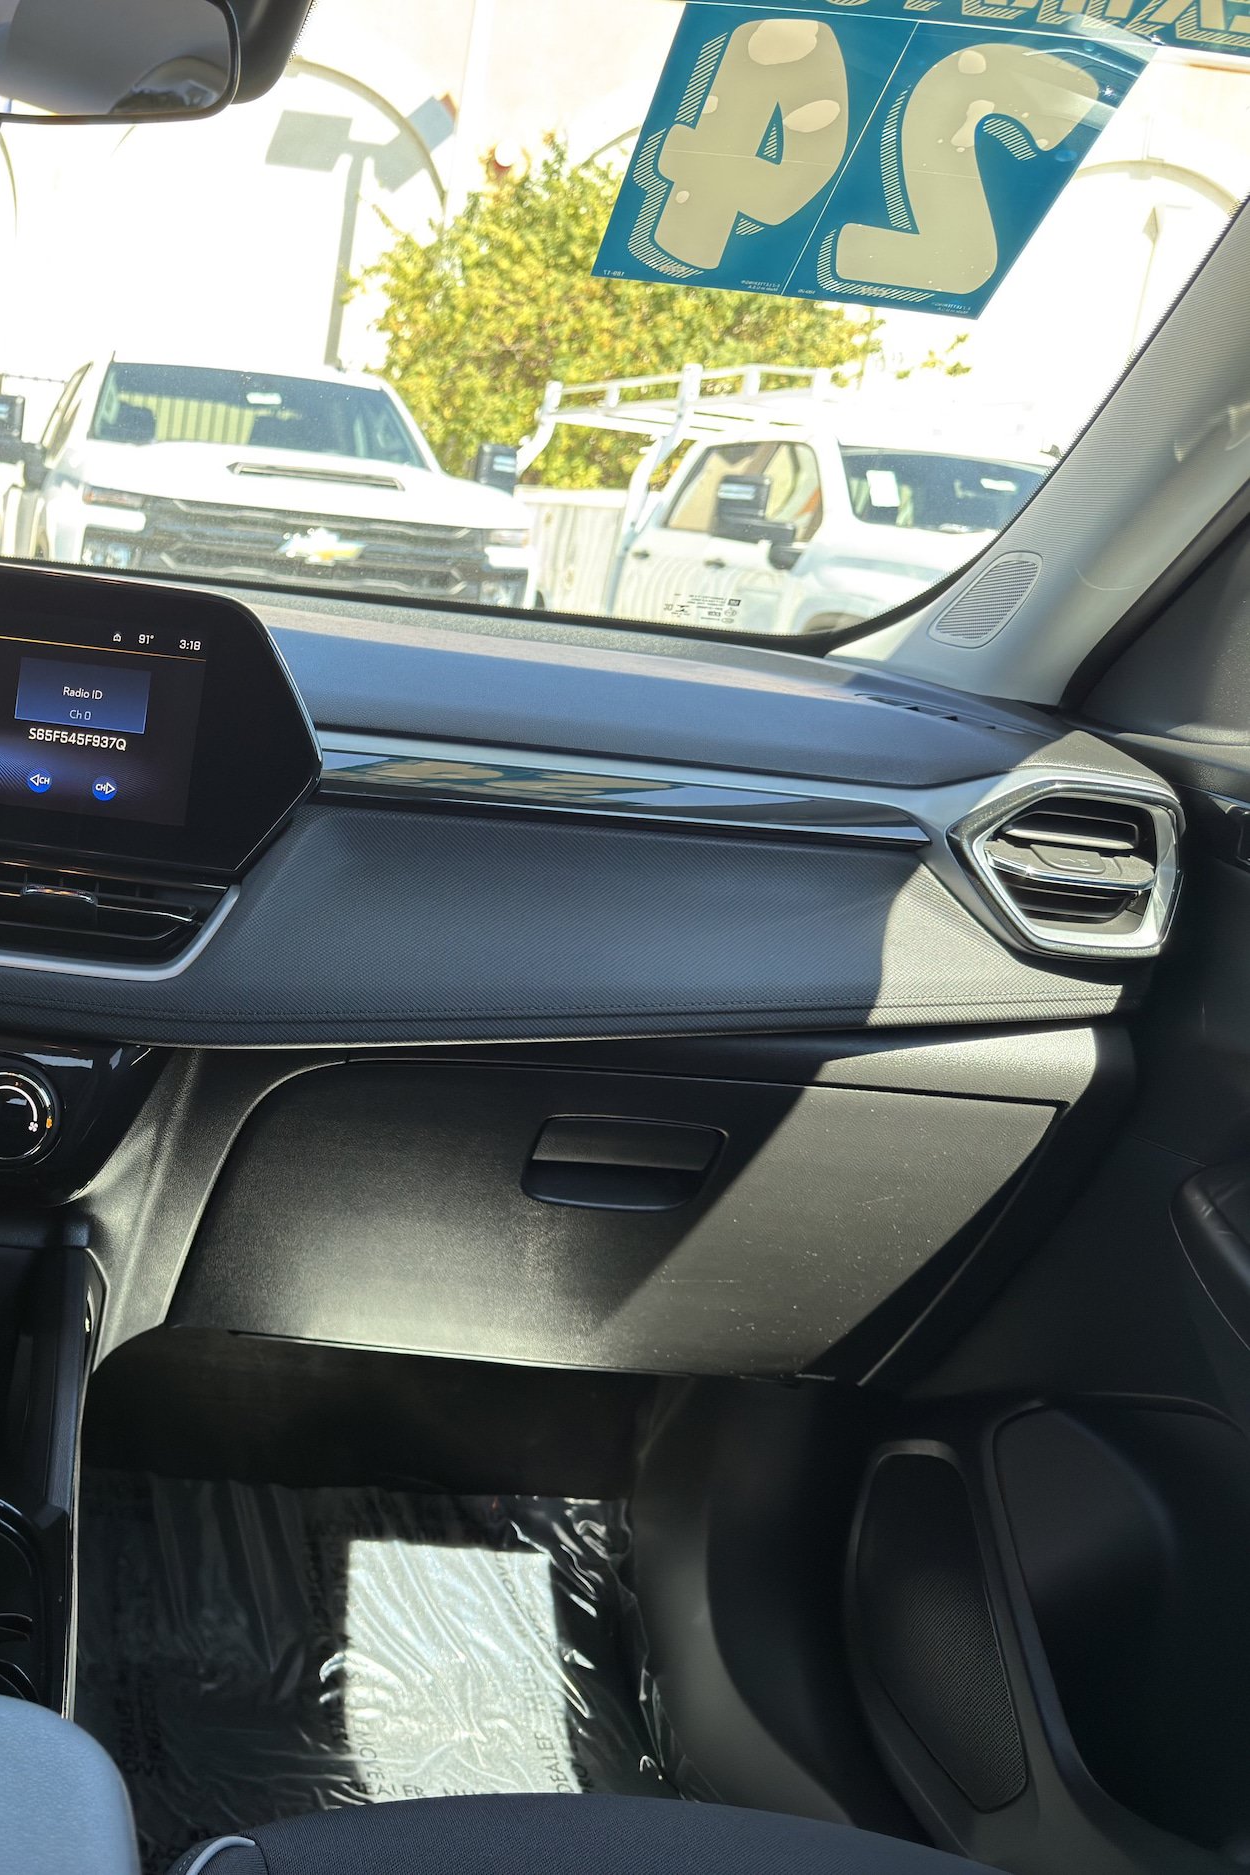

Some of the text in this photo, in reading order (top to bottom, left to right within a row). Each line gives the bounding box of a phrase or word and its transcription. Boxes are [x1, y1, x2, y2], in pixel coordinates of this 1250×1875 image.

[138, 633, 155, 645] 91°
[179, 639, 202, 651] 3:18
[62, 686, 103, 700] Radio ID
[69, 708, 92, 721] Ch 0
[28, 727, 127, 751] S65F545F937Q
